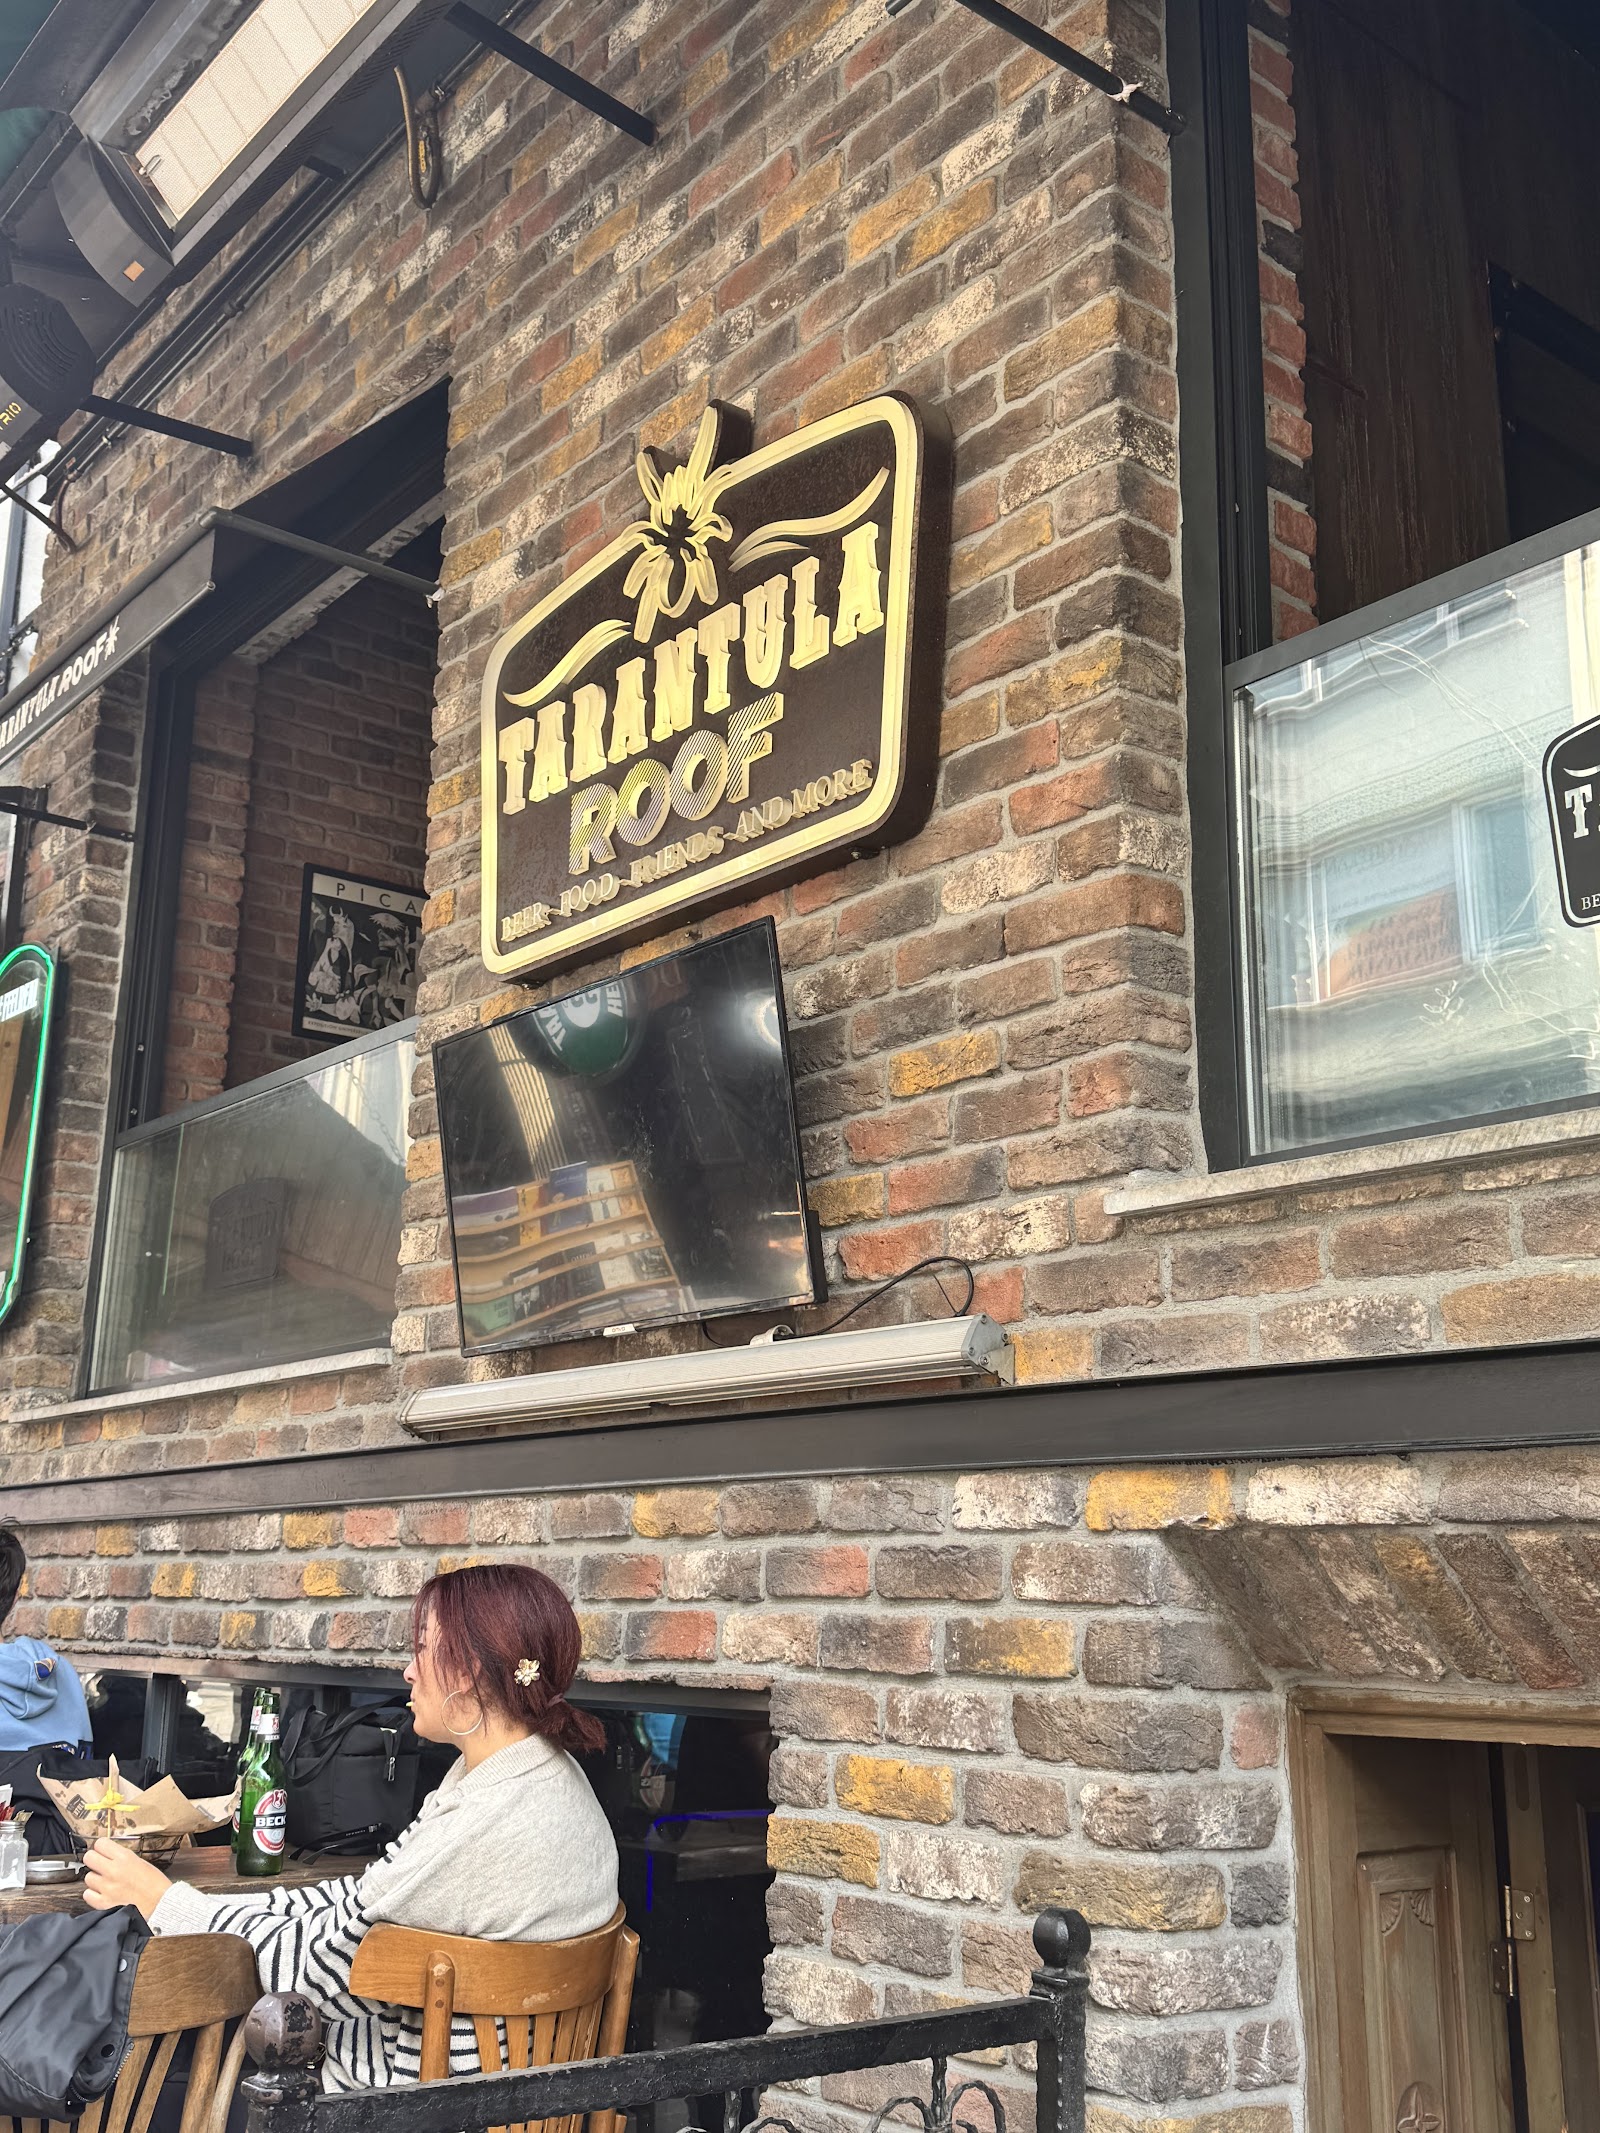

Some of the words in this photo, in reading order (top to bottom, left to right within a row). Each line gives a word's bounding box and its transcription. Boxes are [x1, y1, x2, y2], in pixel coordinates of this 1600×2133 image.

[0, 402, 22, 431] RIO
[57, 631, 108, 698] ROOF
[498, 521, 883, 815] TARANTULA
[568, 692, 784, 875] ROOF
[1564, 783, 1600, 839] T
[501, 901, 551, 942] BEER
[559, 872, 620, 917] FOOD
[629, 826, 725, 888] FRIENDS
[735, 796, 793, 843] AND
[791, 758, 873, 819] MORE
